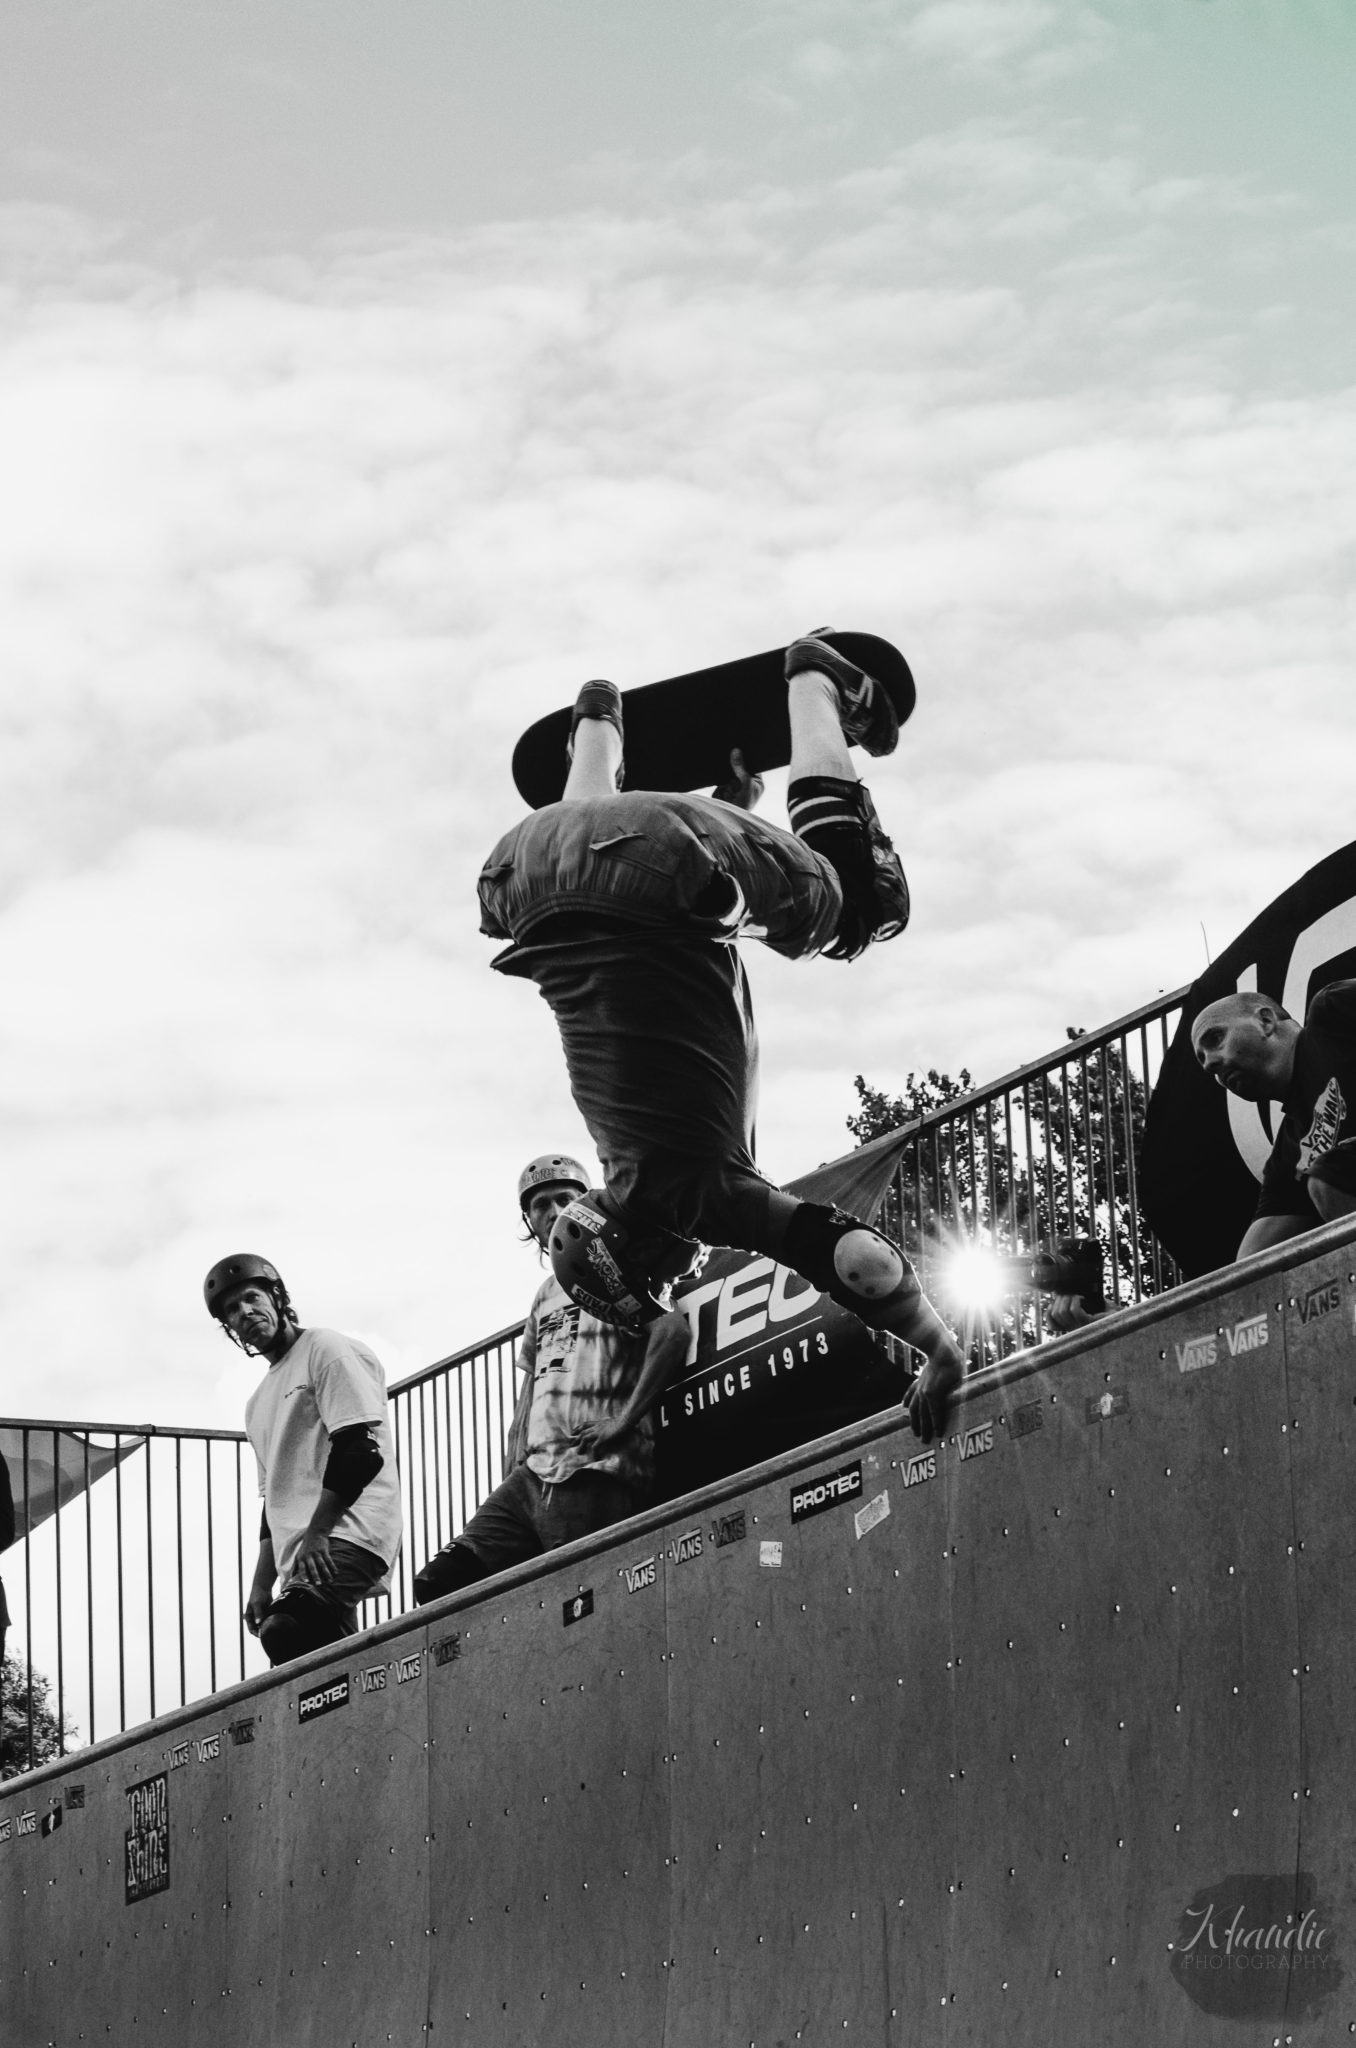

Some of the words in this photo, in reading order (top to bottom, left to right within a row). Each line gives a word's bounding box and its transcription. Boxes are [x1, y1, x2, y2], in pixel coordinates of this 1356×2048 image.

[1296, 1278, 1339, 1324] VANS
[1174, 1333, 1217, 1372] VANS
[1225, 1313, 1269, 1356] VANS
[684, 1365, 751, 1415] SINCE
[768, 1332, 828, 1376] 1973
[900, 1449, 936, 1488] VANS
[957, 1421, 993, 1461] VANS
[792, 1471, 860, 1512] PRO-TEC
[624, 1557, 655, 1593] VANS
[671, 1529, 702, 1564] VANS
[360, 1664, 386, 1693] VANS
[394, 1652, 420, 1684] VANS
[300, 1682, 348, 1715] PRO-TEC
[168, 1741, 189, 1770] VANS
[196, 1733, 220, 1762] VANS
[15, 1811, 37, 1836] VANS
